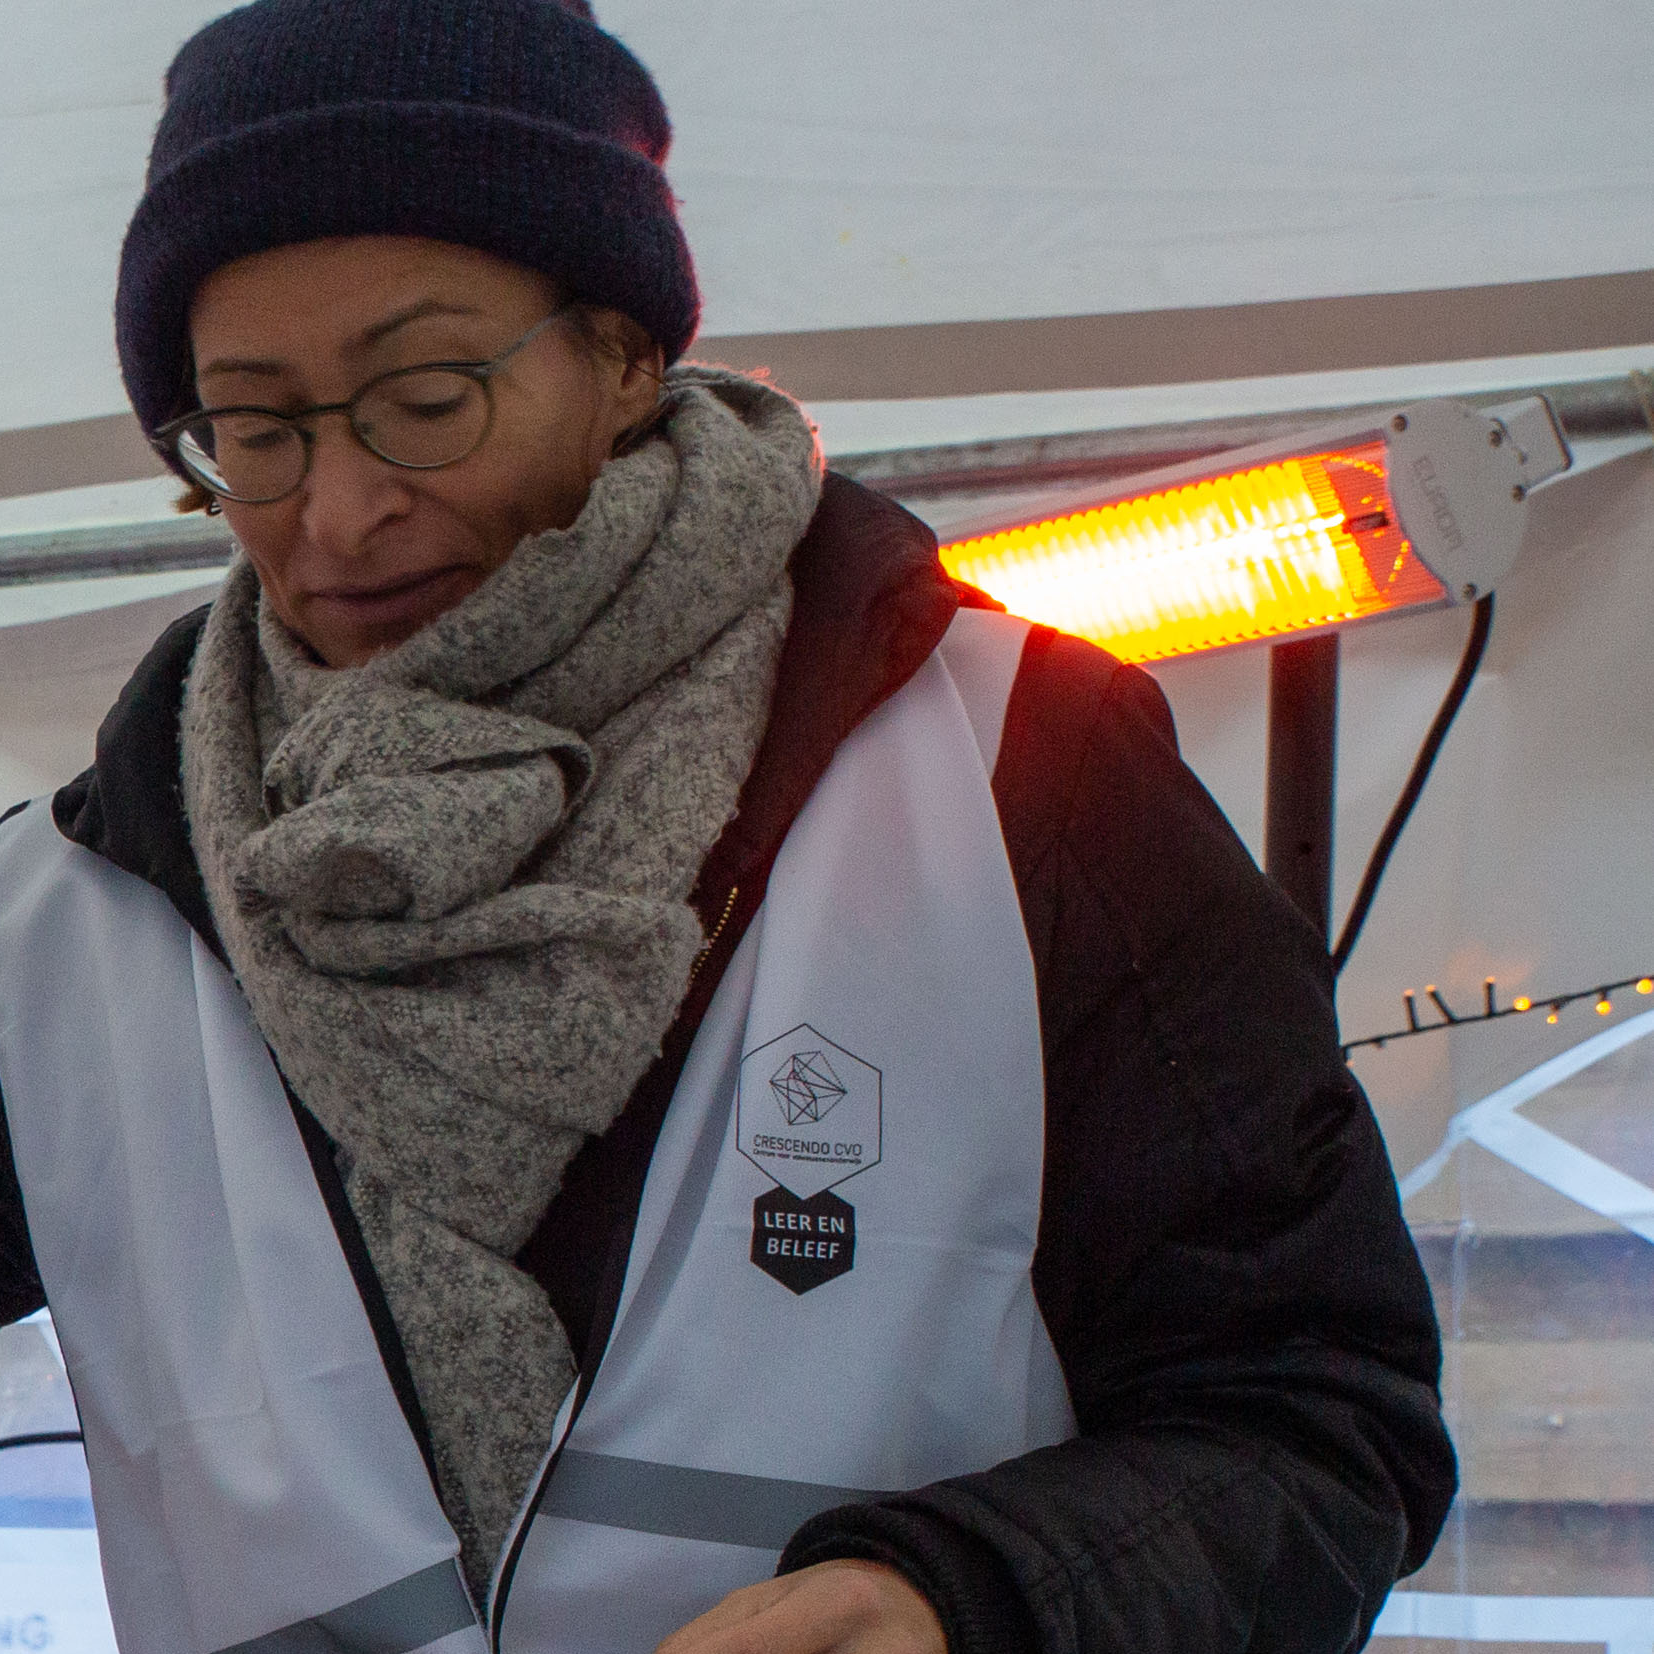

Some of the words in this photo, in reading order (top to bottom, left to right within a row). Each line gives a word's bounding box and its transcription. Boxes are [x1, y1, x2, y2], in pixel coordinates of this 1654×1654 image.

[753, 1134, 830, 1156] CRESCENDO
[834, 1142, 862, 1157] CVO
[764, 1211, 811, 1231] LEER
[818, 1217, 845, 1234] EN
[766, 1238, 840, 1259] BELEEF
